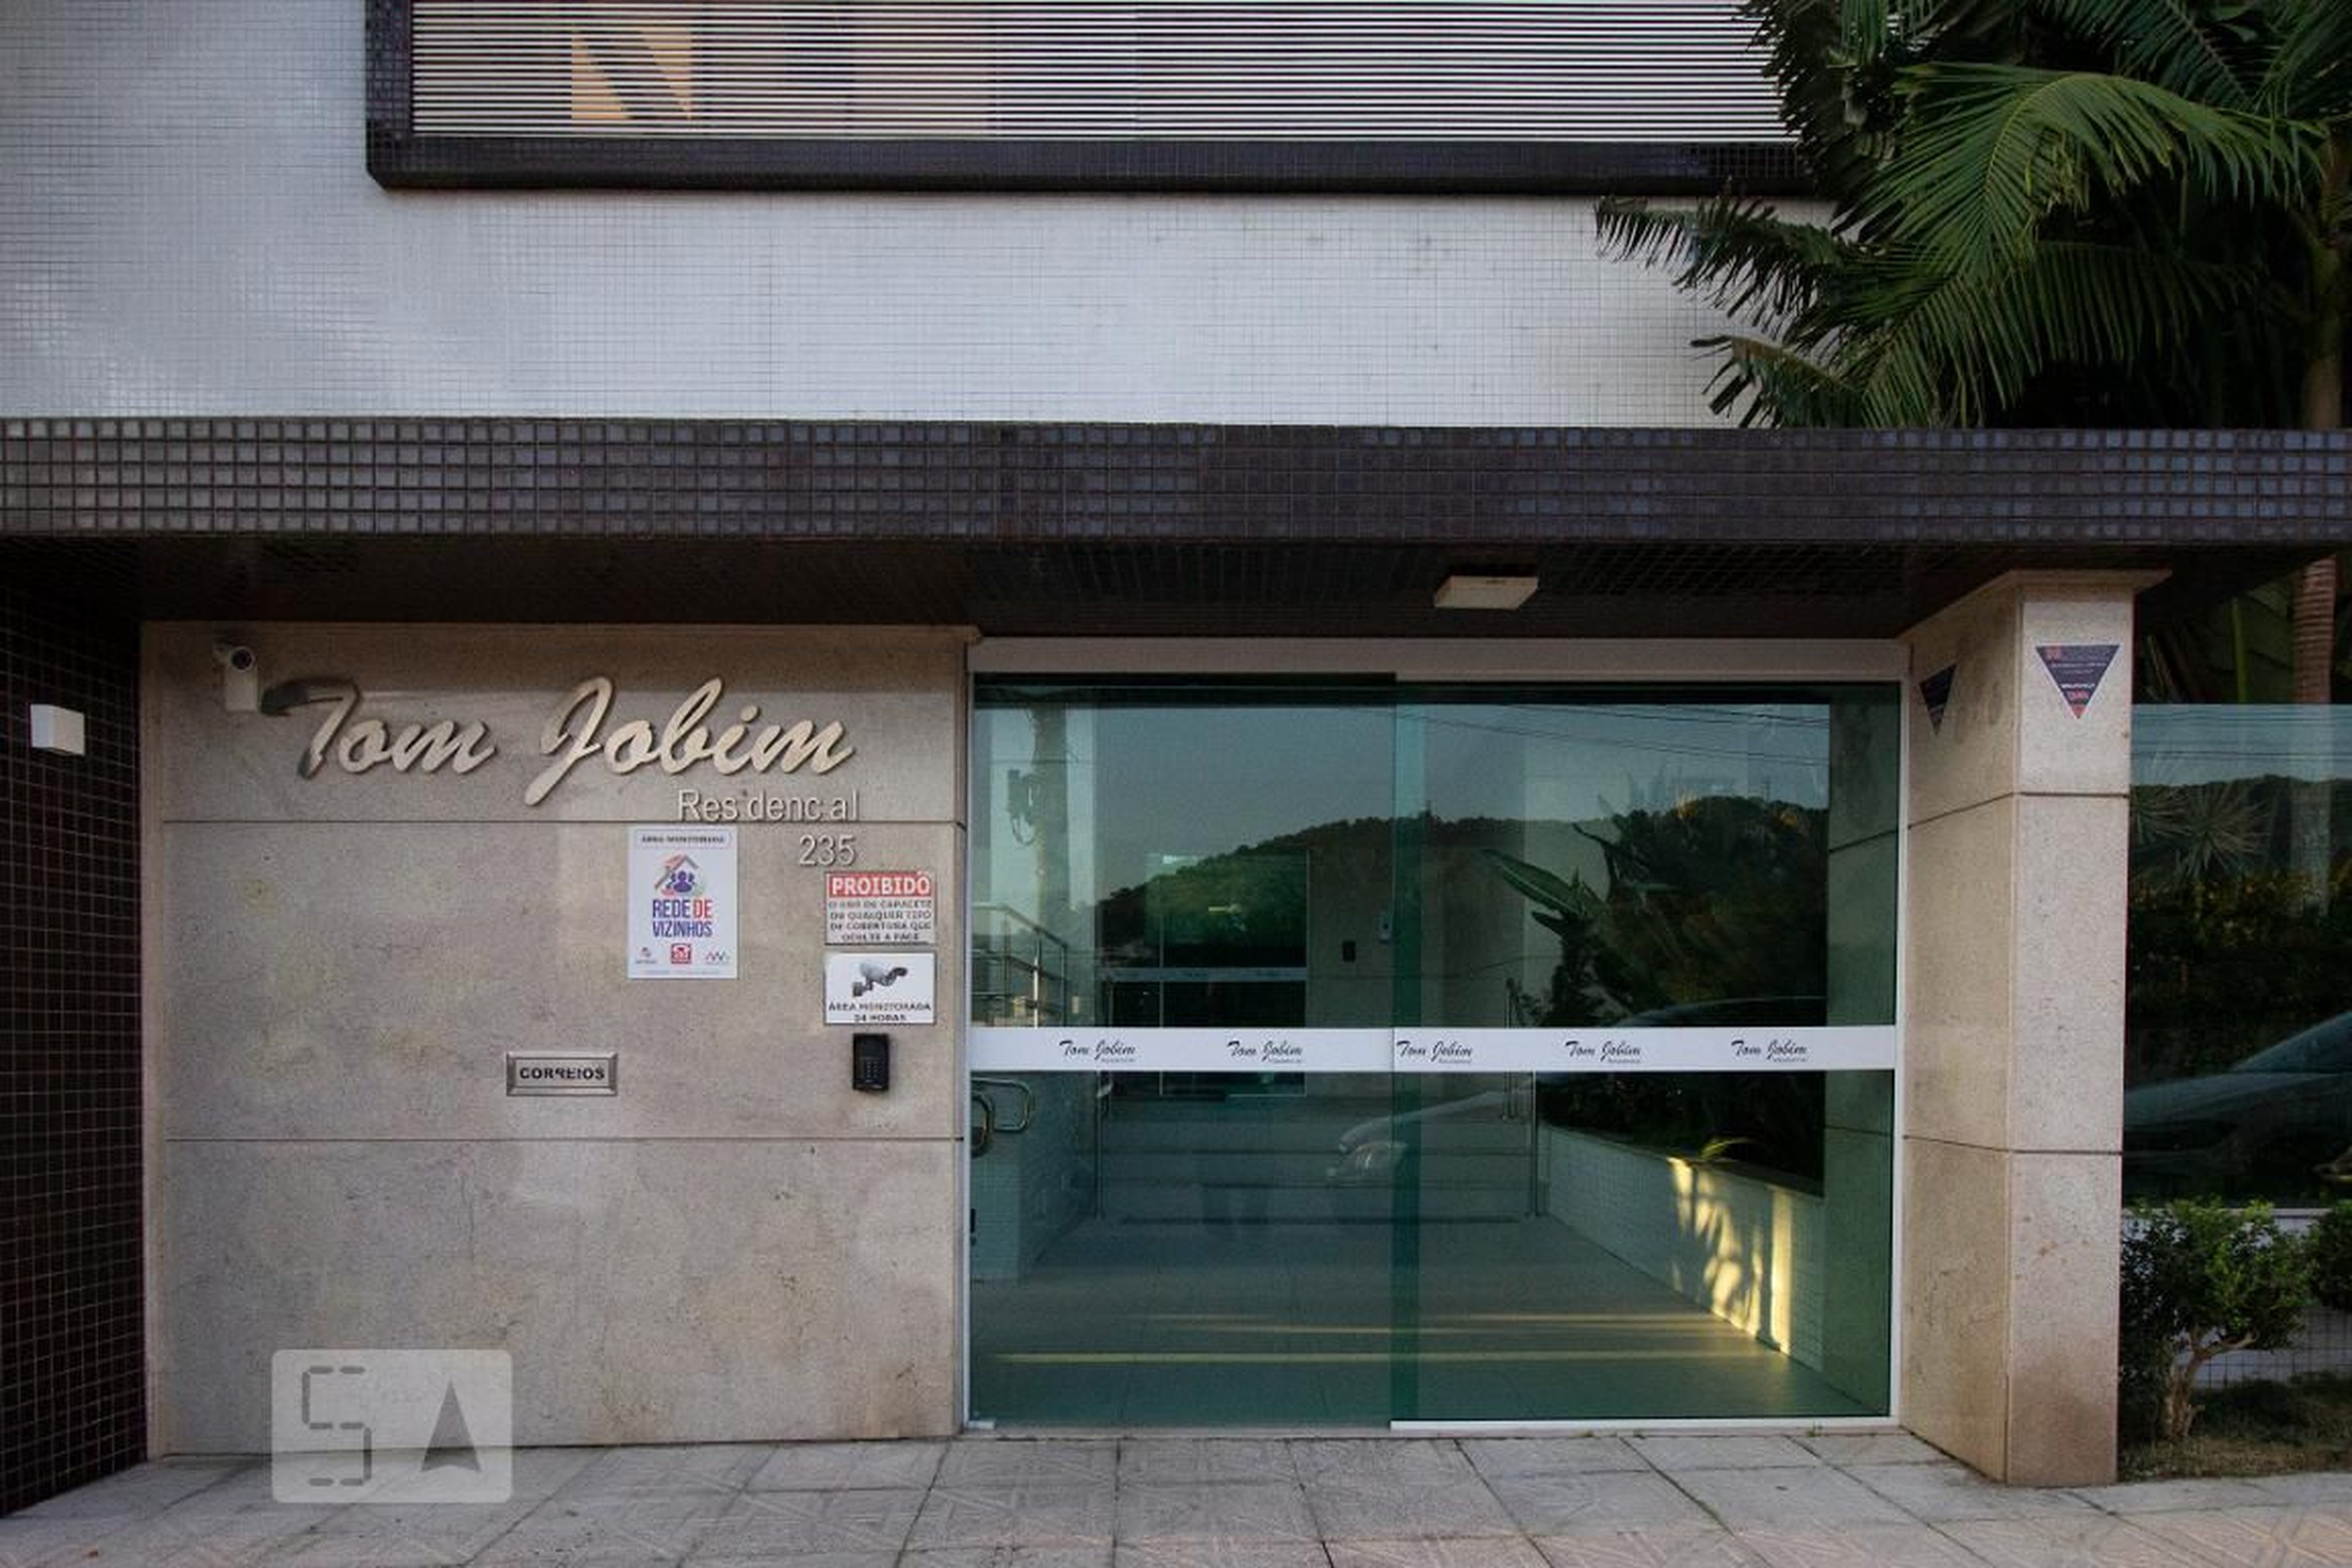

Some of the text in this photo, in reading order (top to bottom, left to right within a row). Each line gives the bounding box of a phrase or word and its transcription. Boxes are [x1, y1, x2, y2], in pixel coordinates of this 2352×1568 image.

[261, 676, 856, 807] Tom Jobim
[678, 788, 859, 821] Resdencal
[799, 834, 857, 866] 235
[832, 876, 930, 895] PROIBIDO
[652, 899, 713, 918] REDE DE
[652, 920, 713, 938] VIZINHOS
[1059, 1039, 1136, 1060] Tom Jobim
[1227, 1039, 1302, 1062] Tom Jobim
[1396, 1040, 1472, 1062] Tom Jobim
[1566, 1040, 1640, 1061] Tom Jobim
[1731, 1039, 1807, 1060] Tom Jobim
[520, 1067, 605, 1080] CORREIOS
